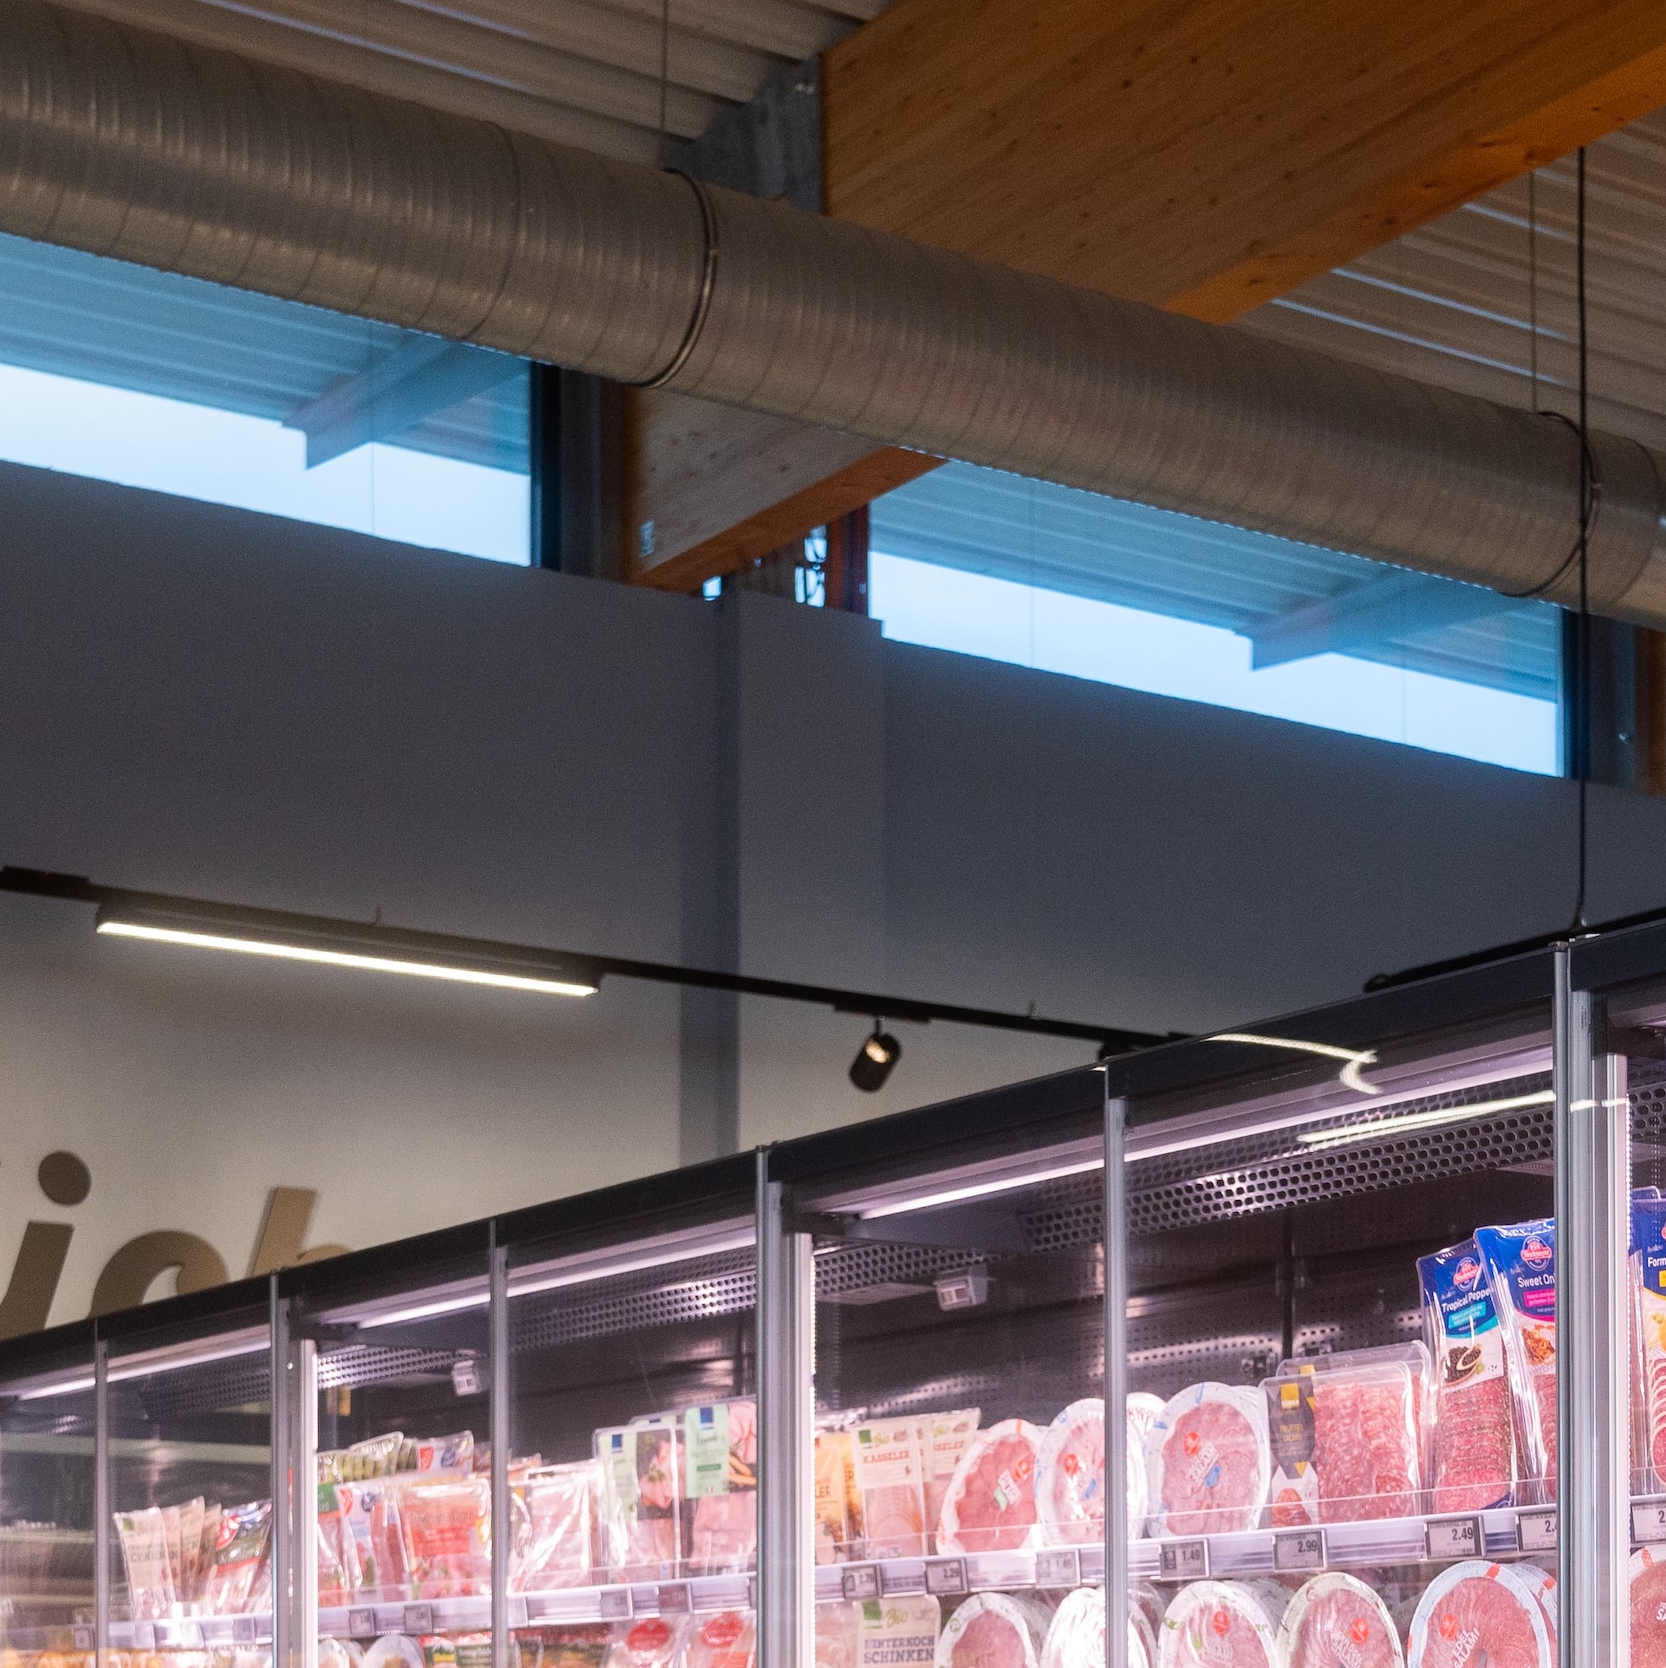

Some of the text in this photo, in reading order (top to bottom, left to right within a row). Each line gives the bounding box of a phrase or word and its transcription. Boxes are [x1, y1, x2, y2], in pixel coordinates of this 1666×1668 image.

[1518, 1276, 1541, 1288] Sweet
[1441, 1297, 1468, 1312] Tropical
[863, 1450, 910, 1464] KASSELER
[1451, 1527, 1474, 1541] 2.49
[1298, 1540, 1318, 1554] 2.99
[1182, 1549, 1200, 1561] 1.49
[887, 1609, 907, 1625] Bio
[864, 1634, 934, 1650] HINTERKOCH
[1451, 1629, 1470, 1657] EDEL
[864, 1648, 934, 1664] SCHINKEN
